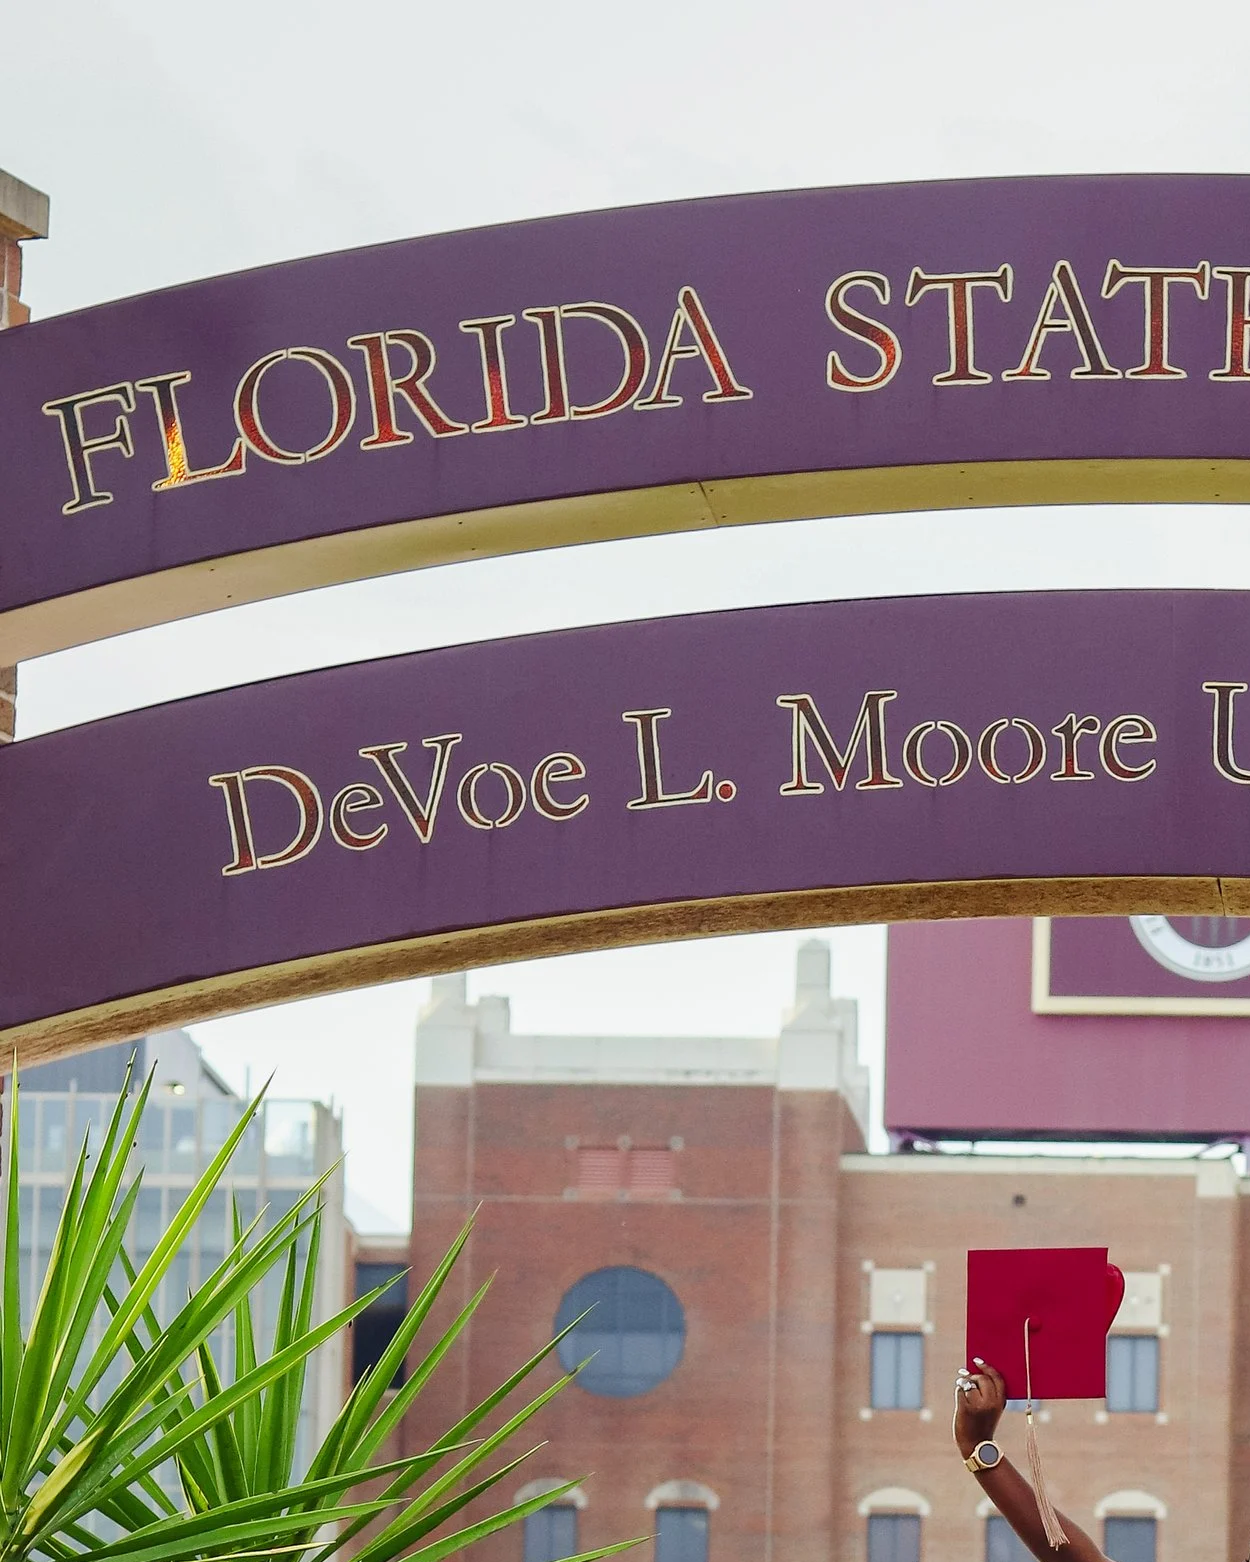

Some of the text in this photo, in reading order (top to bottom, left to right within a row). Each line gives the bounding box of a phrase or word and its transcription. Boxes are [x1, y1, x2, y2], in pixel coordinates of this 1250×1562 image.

[41, 285, 753, 516] FLORIDA
[209, 734, 589, 875] DeVoe
[622, 708, 737, 810] L.
[776, 689, 1157, 795] Moore
